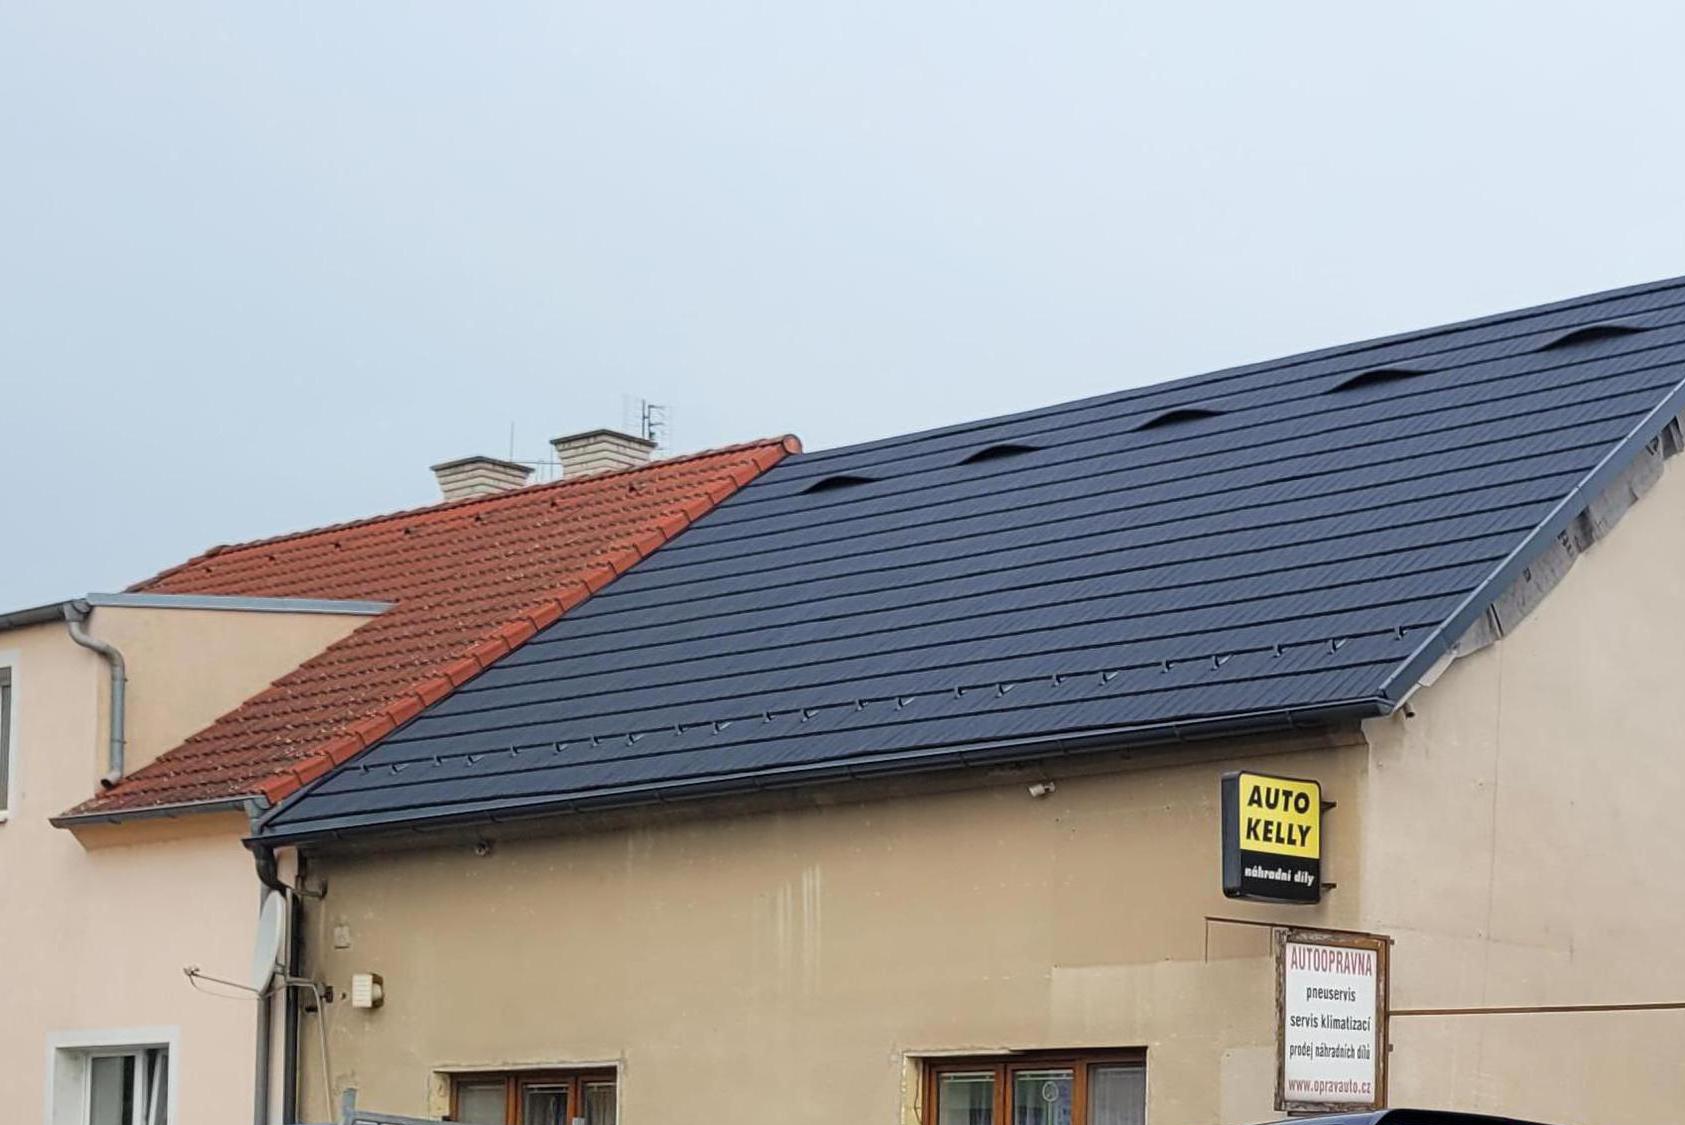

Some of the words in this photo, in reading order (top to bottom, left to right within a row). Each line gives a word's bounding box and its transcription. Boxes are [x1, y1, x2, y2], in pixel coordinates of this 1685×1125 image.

[1247, 785, 1310, 814] AUTO
[1246, 817, 1311, 847] KELLY
[1294, 870, 1315, 887] díly
[1290, 946, 1372, 976] AUTOOPRAVNA
[1306, 986, 1356, 1002] pneuservis
[1290, 1013, 1318, 1028] servis
[1321, 1014, 1371, 1031] klimatizací
[1289, 1042, 1313, 1060] prodej
[1288, 1078, 1372, 1096] www.opravauto.cz
